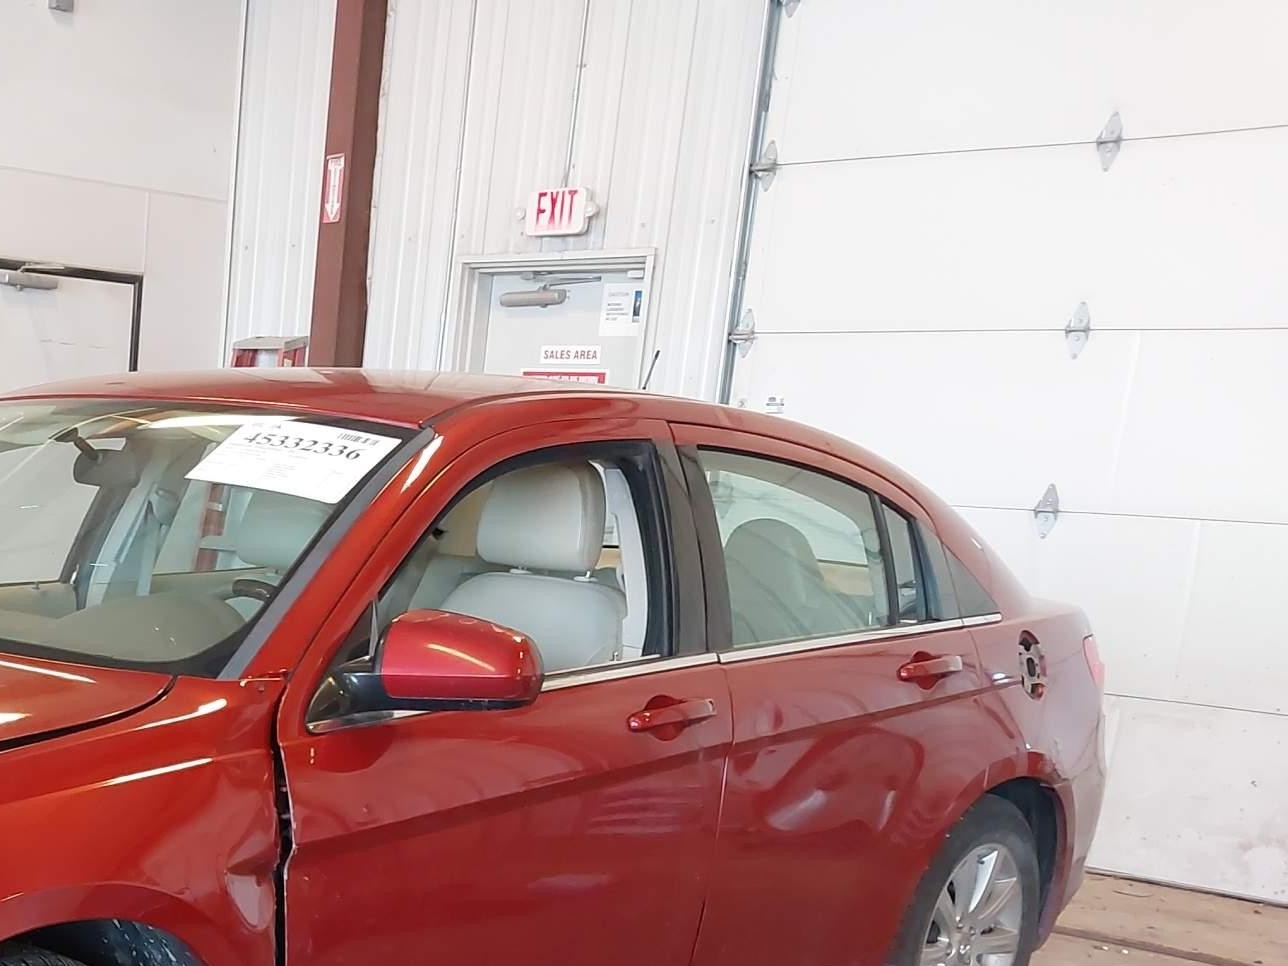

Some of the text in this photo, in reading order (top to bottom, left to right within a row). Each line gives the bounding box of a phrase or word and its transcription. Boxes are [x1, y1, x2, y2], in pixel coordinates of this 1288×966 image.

[535, 189, 578, 228] EXIT
[543, 350, 598, 360] SALES AREA
[243, 432, 362, 461] 45332336
